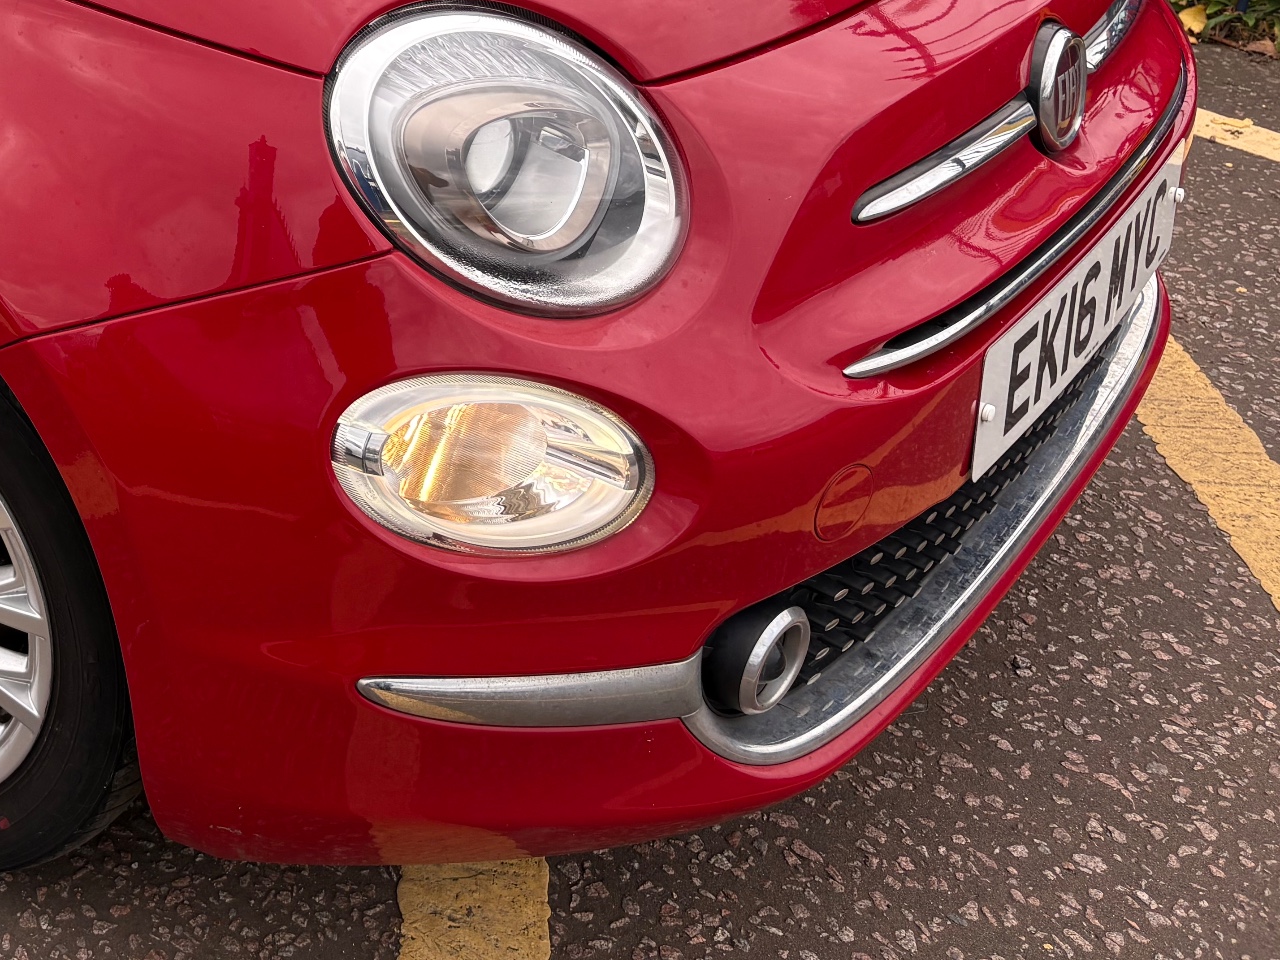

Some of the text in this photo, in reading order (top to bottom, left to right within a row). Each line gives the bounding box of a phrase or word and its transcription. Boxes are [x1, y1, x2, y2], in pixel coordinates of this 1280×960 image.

[1057, 58, 1080, 123] FIAT
[1003, 178, 1168, 437] EK16 MYC
